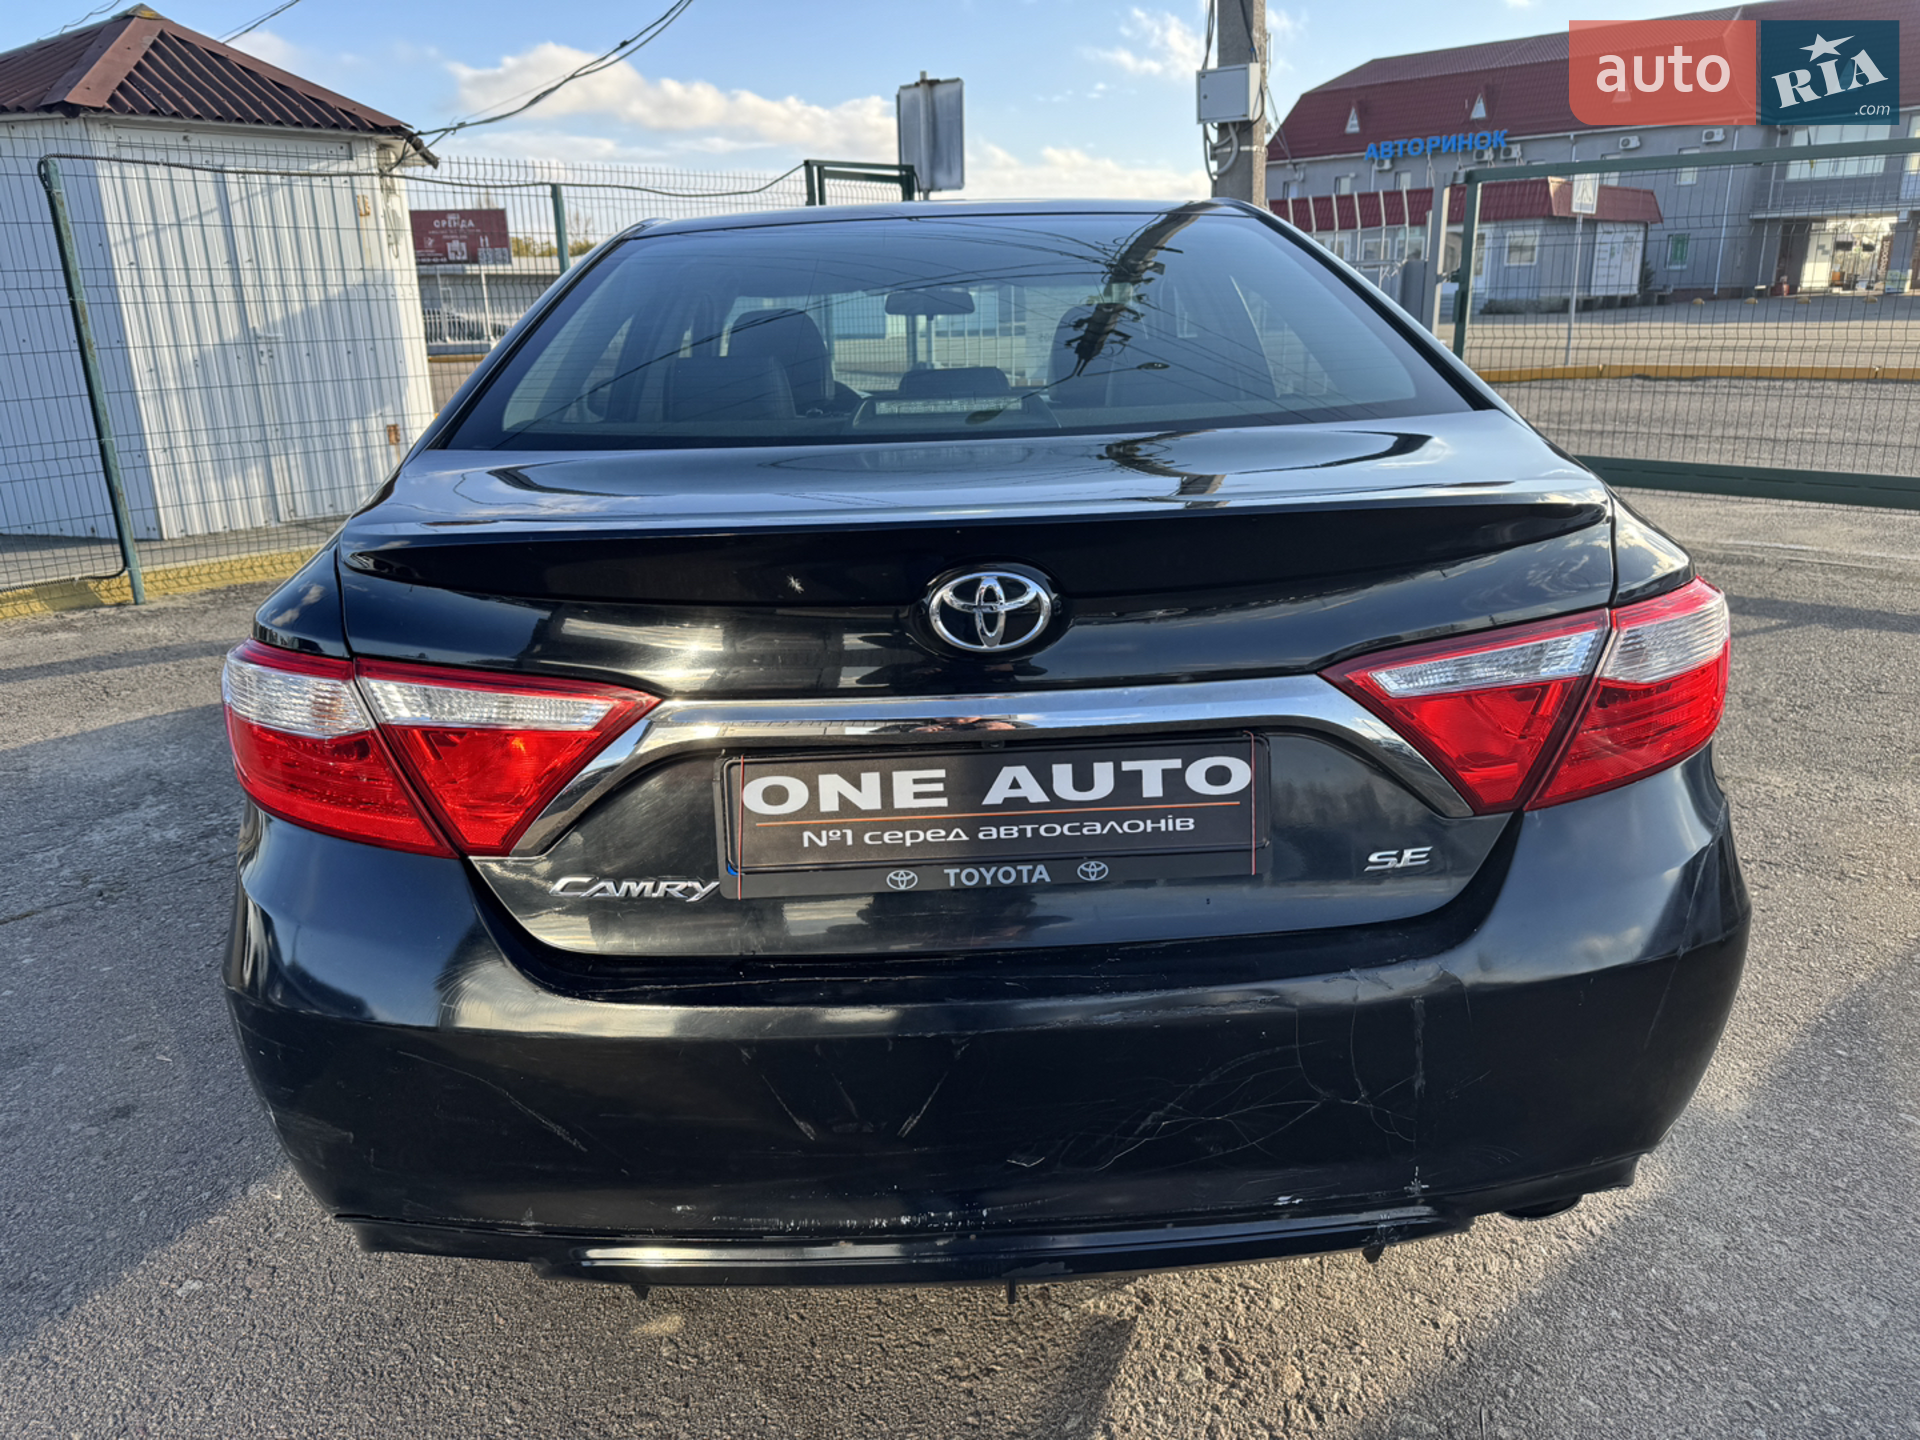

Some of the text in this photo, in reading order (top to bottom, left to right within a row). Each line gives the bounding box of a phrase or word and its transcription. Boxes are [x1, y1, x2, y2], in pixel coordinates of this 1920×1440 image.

[1364, 129, 1508, 161] АВТОРИНОК
[433, 219, 475, 229] ОРЕНДА
[743, 755, 1252, 815] ONE AUTO
[863, 827, 969, 847] серед
[977, 815, 1195, 840] автосалонів
[1363, 846, 1433, 872] SE
[943, 864, 1051, 887] TOYOTA
